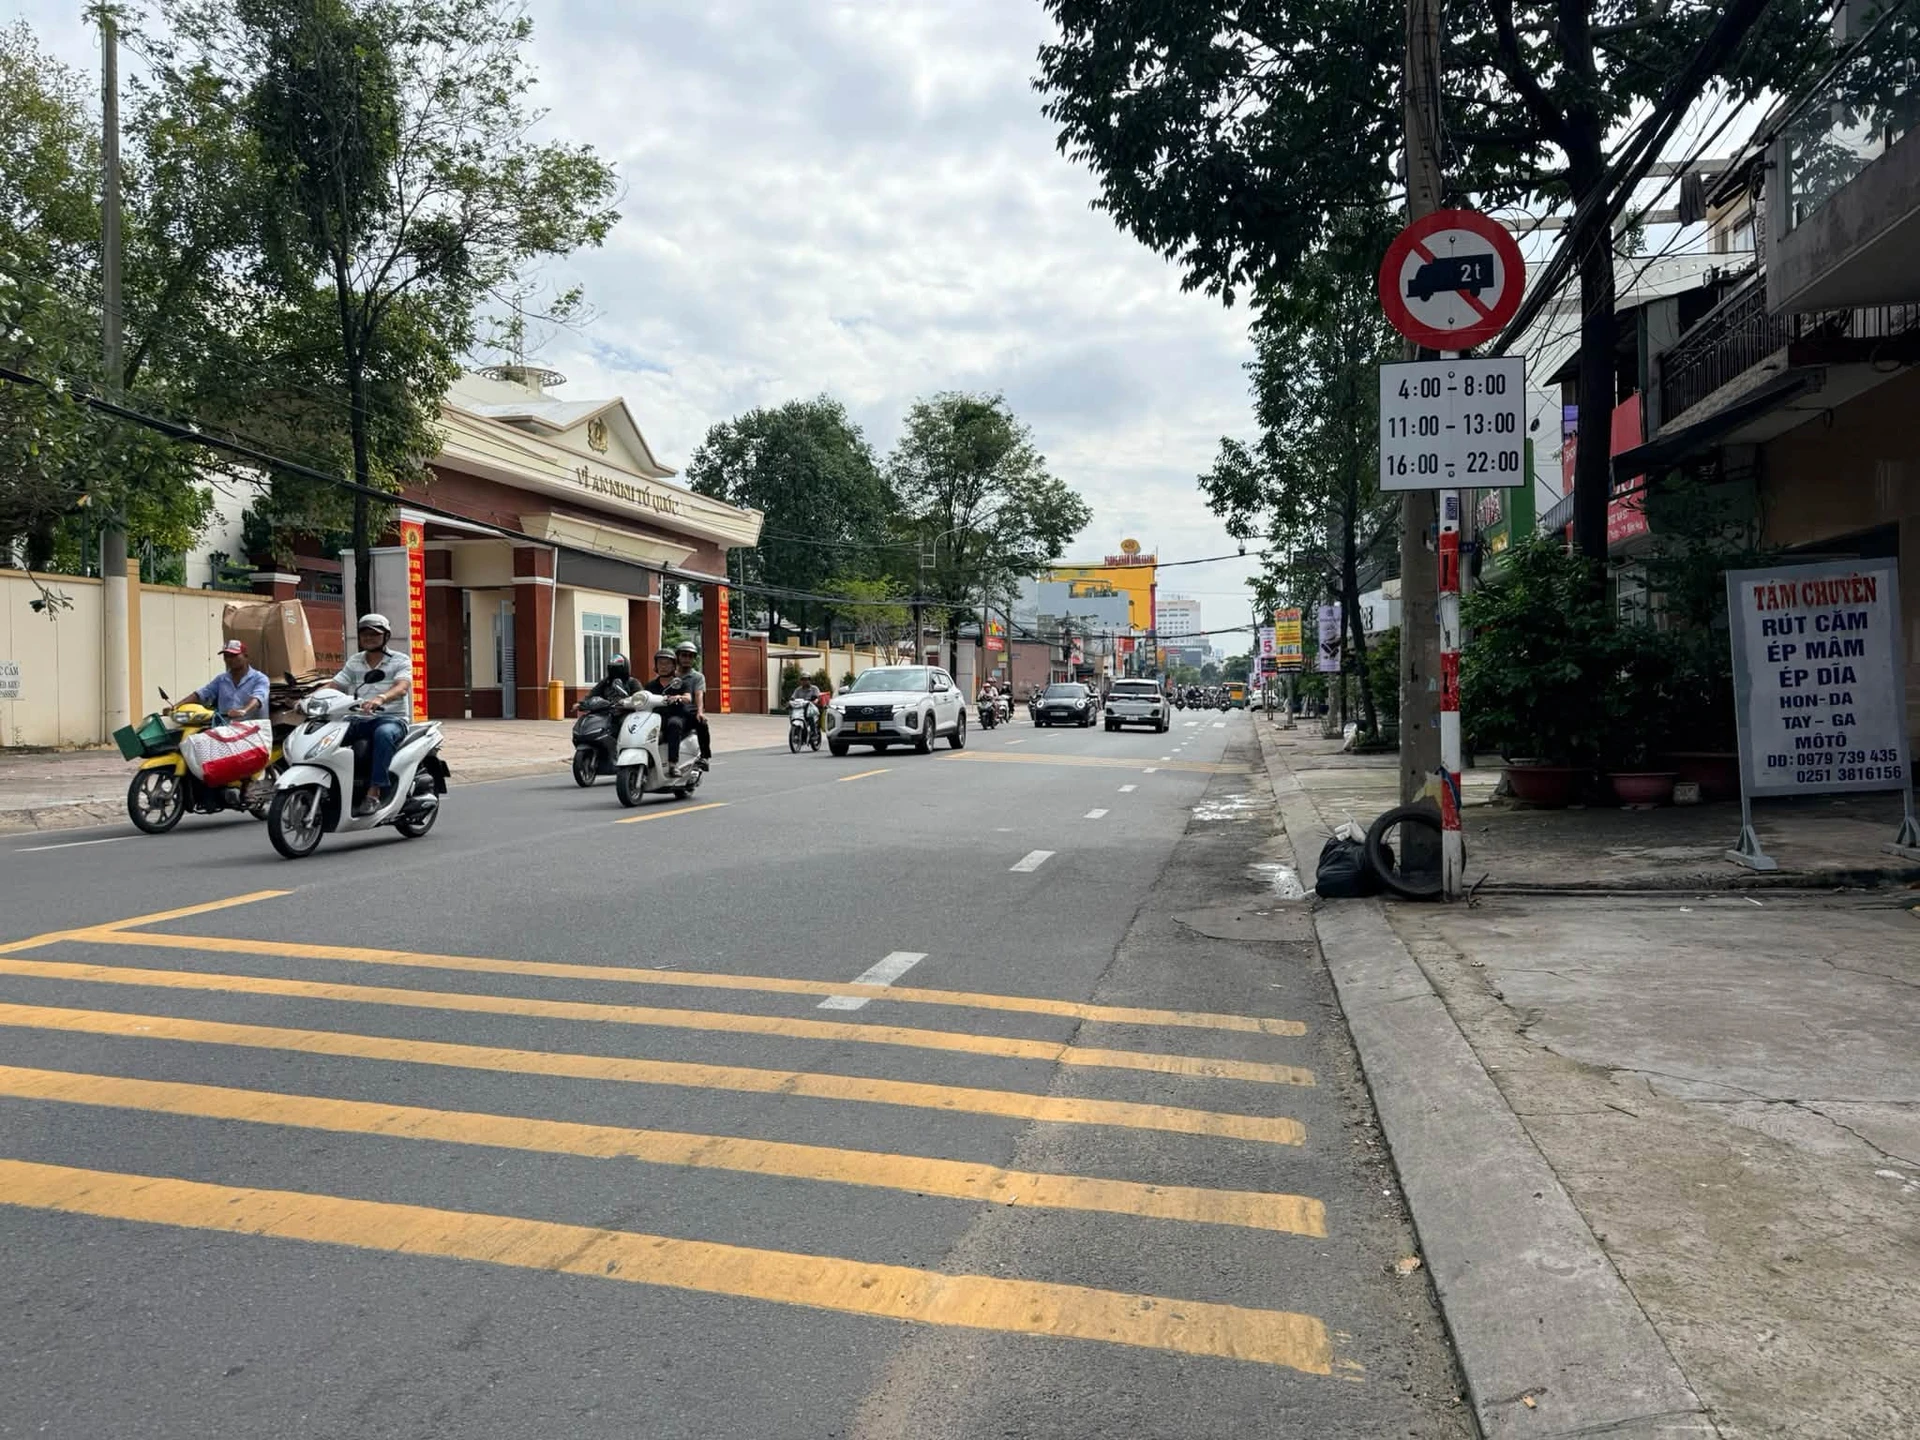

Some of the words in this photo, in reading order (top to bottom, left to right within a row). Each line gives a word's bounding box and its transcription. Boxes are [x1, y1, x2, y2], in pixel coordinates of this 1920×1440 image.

[1398, 377, 1441, 400] 4:00
[1464, 373, 1506, 397] 8:00
[1388, 415, 1439, 438] 11:00
[1463, 412, 1516, 436] 13:00
[1387, 453, 1439, 476] 16:00
[1466, 450, 1519, 473] 22:00
[1754, 580, 1798, 611] TÁM
[1801, 573, 1877, 607] CHUYÊN
[1762, 612, 1807, 637] RÚT
[1815, 609, 1868, 633] CĂM
[1767, 640, 1797, 663] ÉP
[1805, 635, 1865, 660] MÂM
[1779, 665, 1809, 689] ÉP
[1831, 712, 1857, 727] GA
[1795, 731, 1847, 750] MÔTÔ
[1797, 751, 1833, 766] 0979
[1837, 750, 1866, 765] 739
[1869, 748, 1898, 763] 435
[1796, 769, 1831, 784] 0251
[1837, 765, 1902, 782] 3816156
